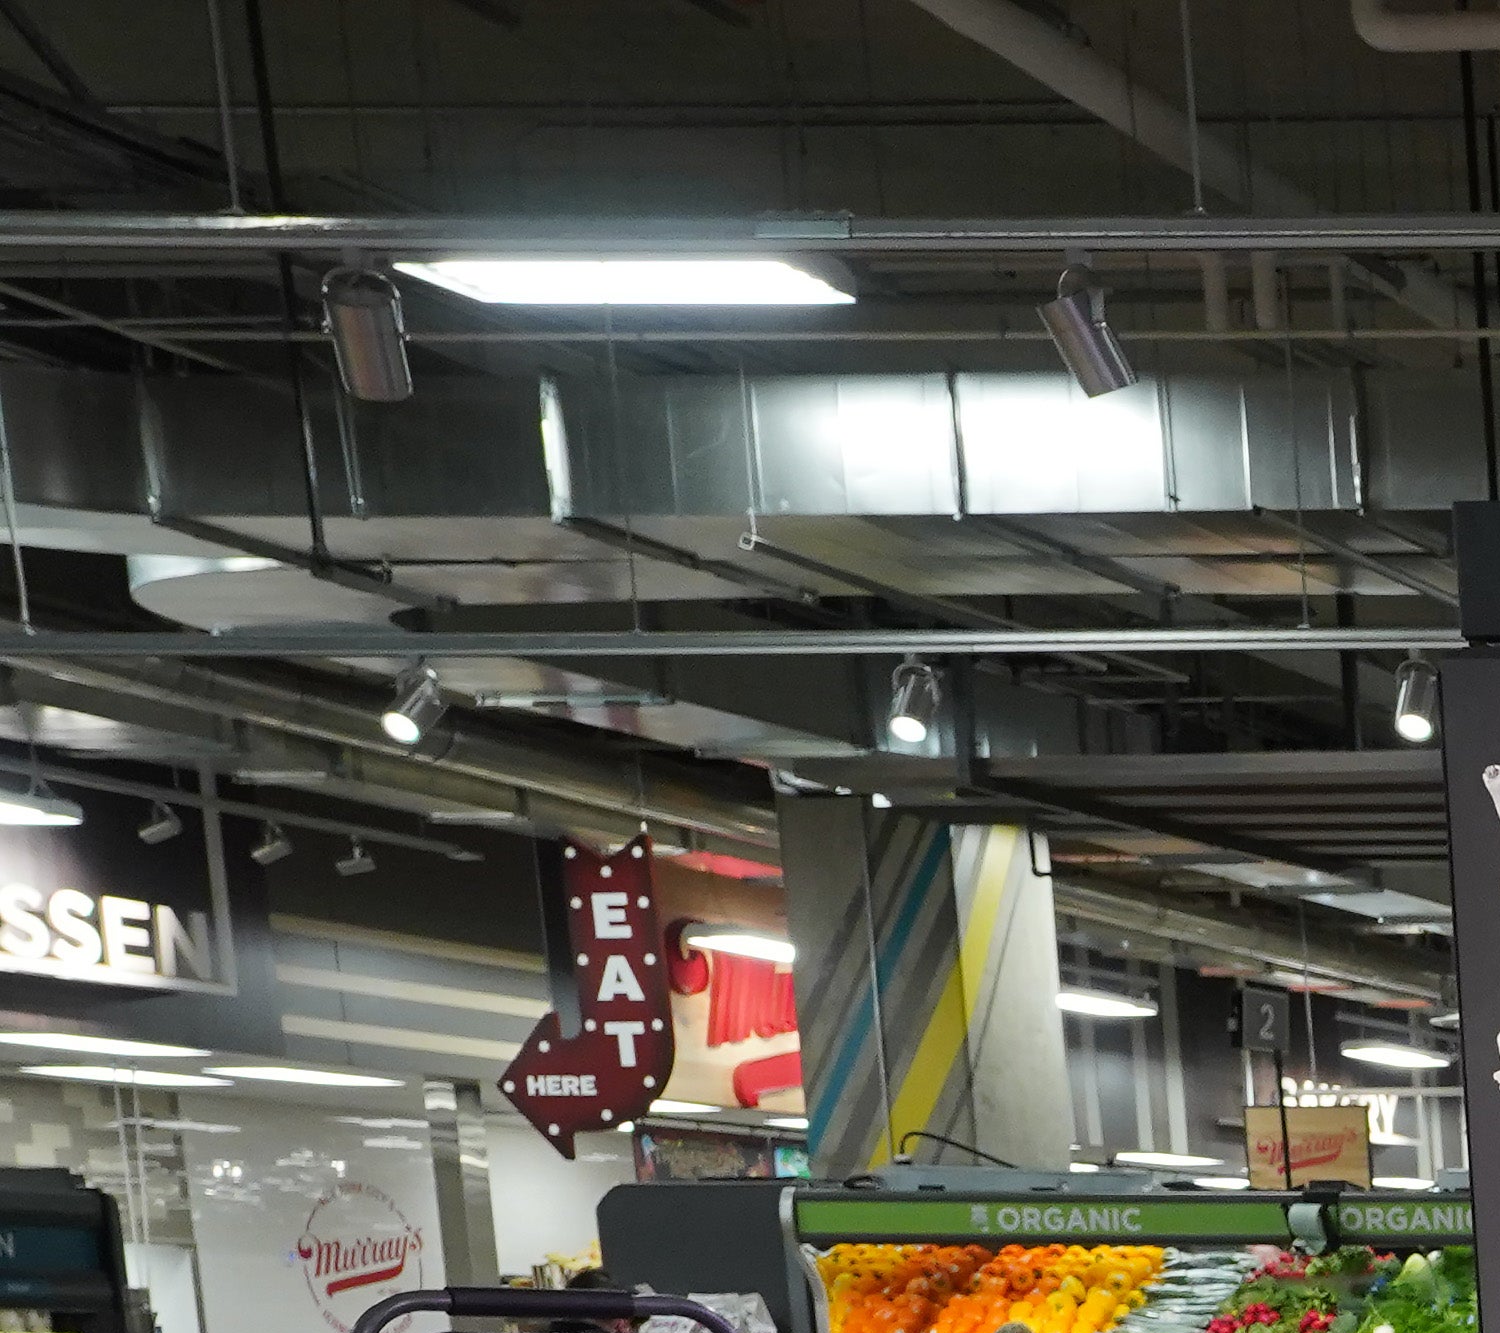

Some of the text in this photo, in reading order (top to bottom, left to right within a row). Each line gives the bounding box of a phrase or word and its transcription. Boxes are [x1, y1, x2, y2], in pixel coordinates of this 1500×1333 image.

[591, 892, 645, 1067] EAT
[527, 1076, 597, 1095] HERE
[997, 1207, 1142, 1232] ORGANIC
